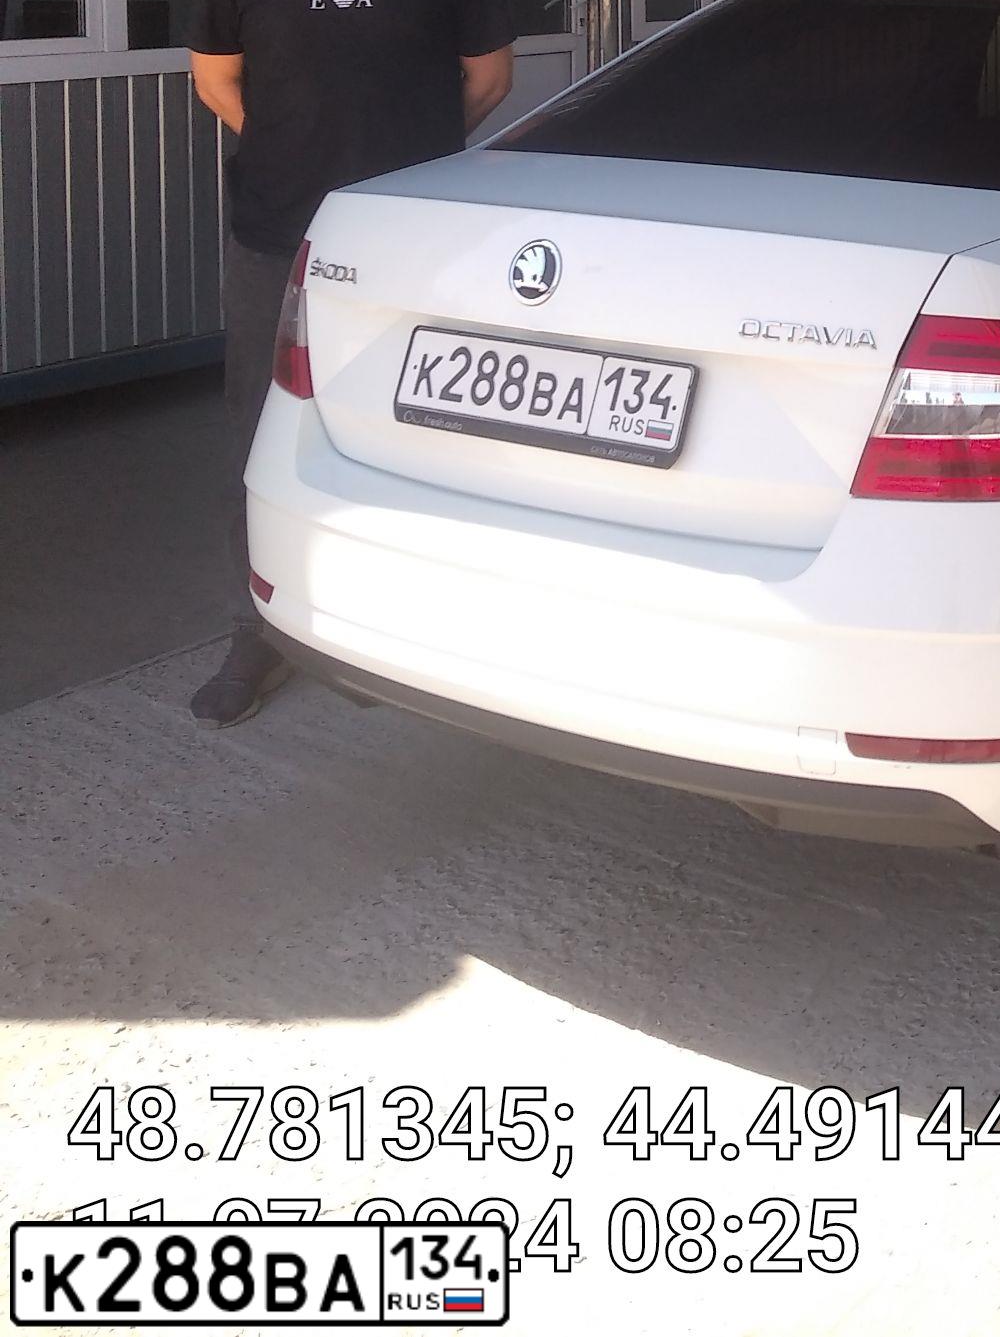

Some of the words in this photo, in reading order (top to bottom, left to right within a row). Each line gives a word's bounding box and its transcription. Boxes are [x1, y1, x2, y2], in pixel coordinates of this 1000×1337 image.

[738, 318, 878, 350] OCTAVIA
[604, 366, 673, 420] 134
[608, 414, 645, 436] RUS
